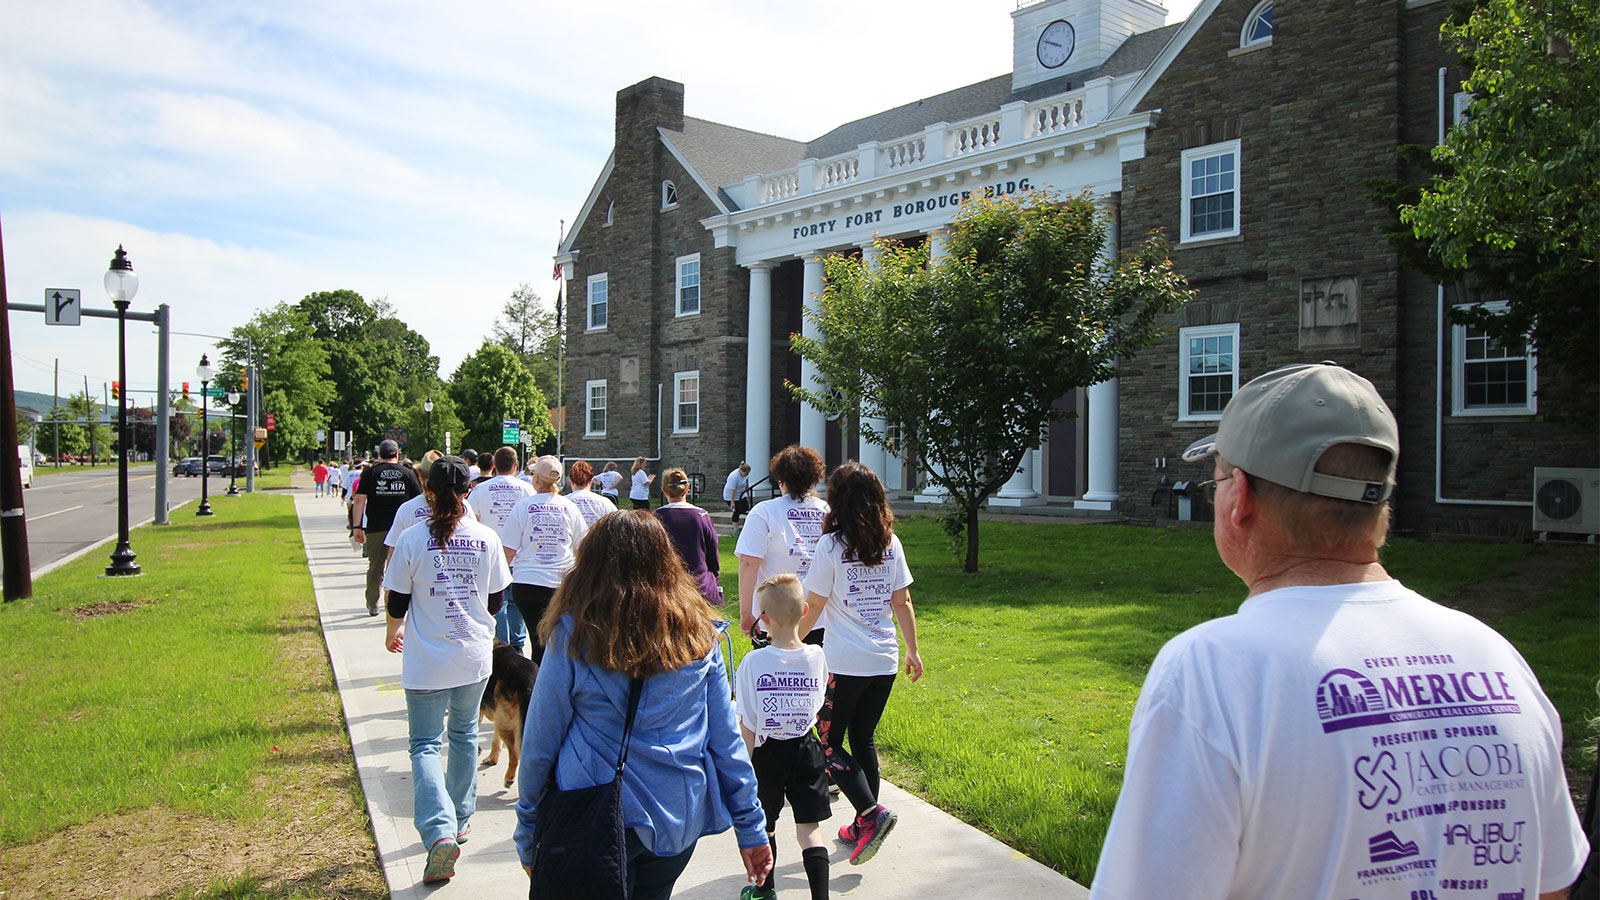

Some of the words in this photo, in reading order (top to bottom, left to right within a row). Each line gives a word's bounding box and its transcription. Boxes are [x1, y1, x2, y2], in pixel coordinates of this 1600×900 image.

[793, 219, 837, 239] FORTY
[845, 209, 883, 228] FORT
[893, 191, 971, 218] BOROUGH
[984, 178, 1035, 200] BLDG.
[802, 524, 821, 532] JACO
[447, 539, 486, 548] MERICLE
[446, 555, 480, 565] JACOBI
[860, 566, 890, 576] JACOBI
[1364, 656, 1400, 668] EVENT
[1406, 654, 1455, 665] SPONSOR
[777, 677, 818, 688] MERICLE
[1381, 671, 1515, 708] MERICLE
[780, 698, 814, 709] JACOBI
[1390, 708, 1440, 721] COMMERCIAL
[1441, 706, 1464, 716] REAL
[1372, 729, 1438, 747] PRESENTING
[1444, 725, 1498, 737] SPONSOR
[1405, 743, 1524, 793] JACOBI
[1459, 779, 1524, 792] MANAGEMENT
[1386, 803, 1447, 823] PLATINUM
[1443, 821, 1525, 845] HALIBUT
[1474, 843, 1522, 866] BLUE
[1439, 878, 1488, 890] ONSORS
